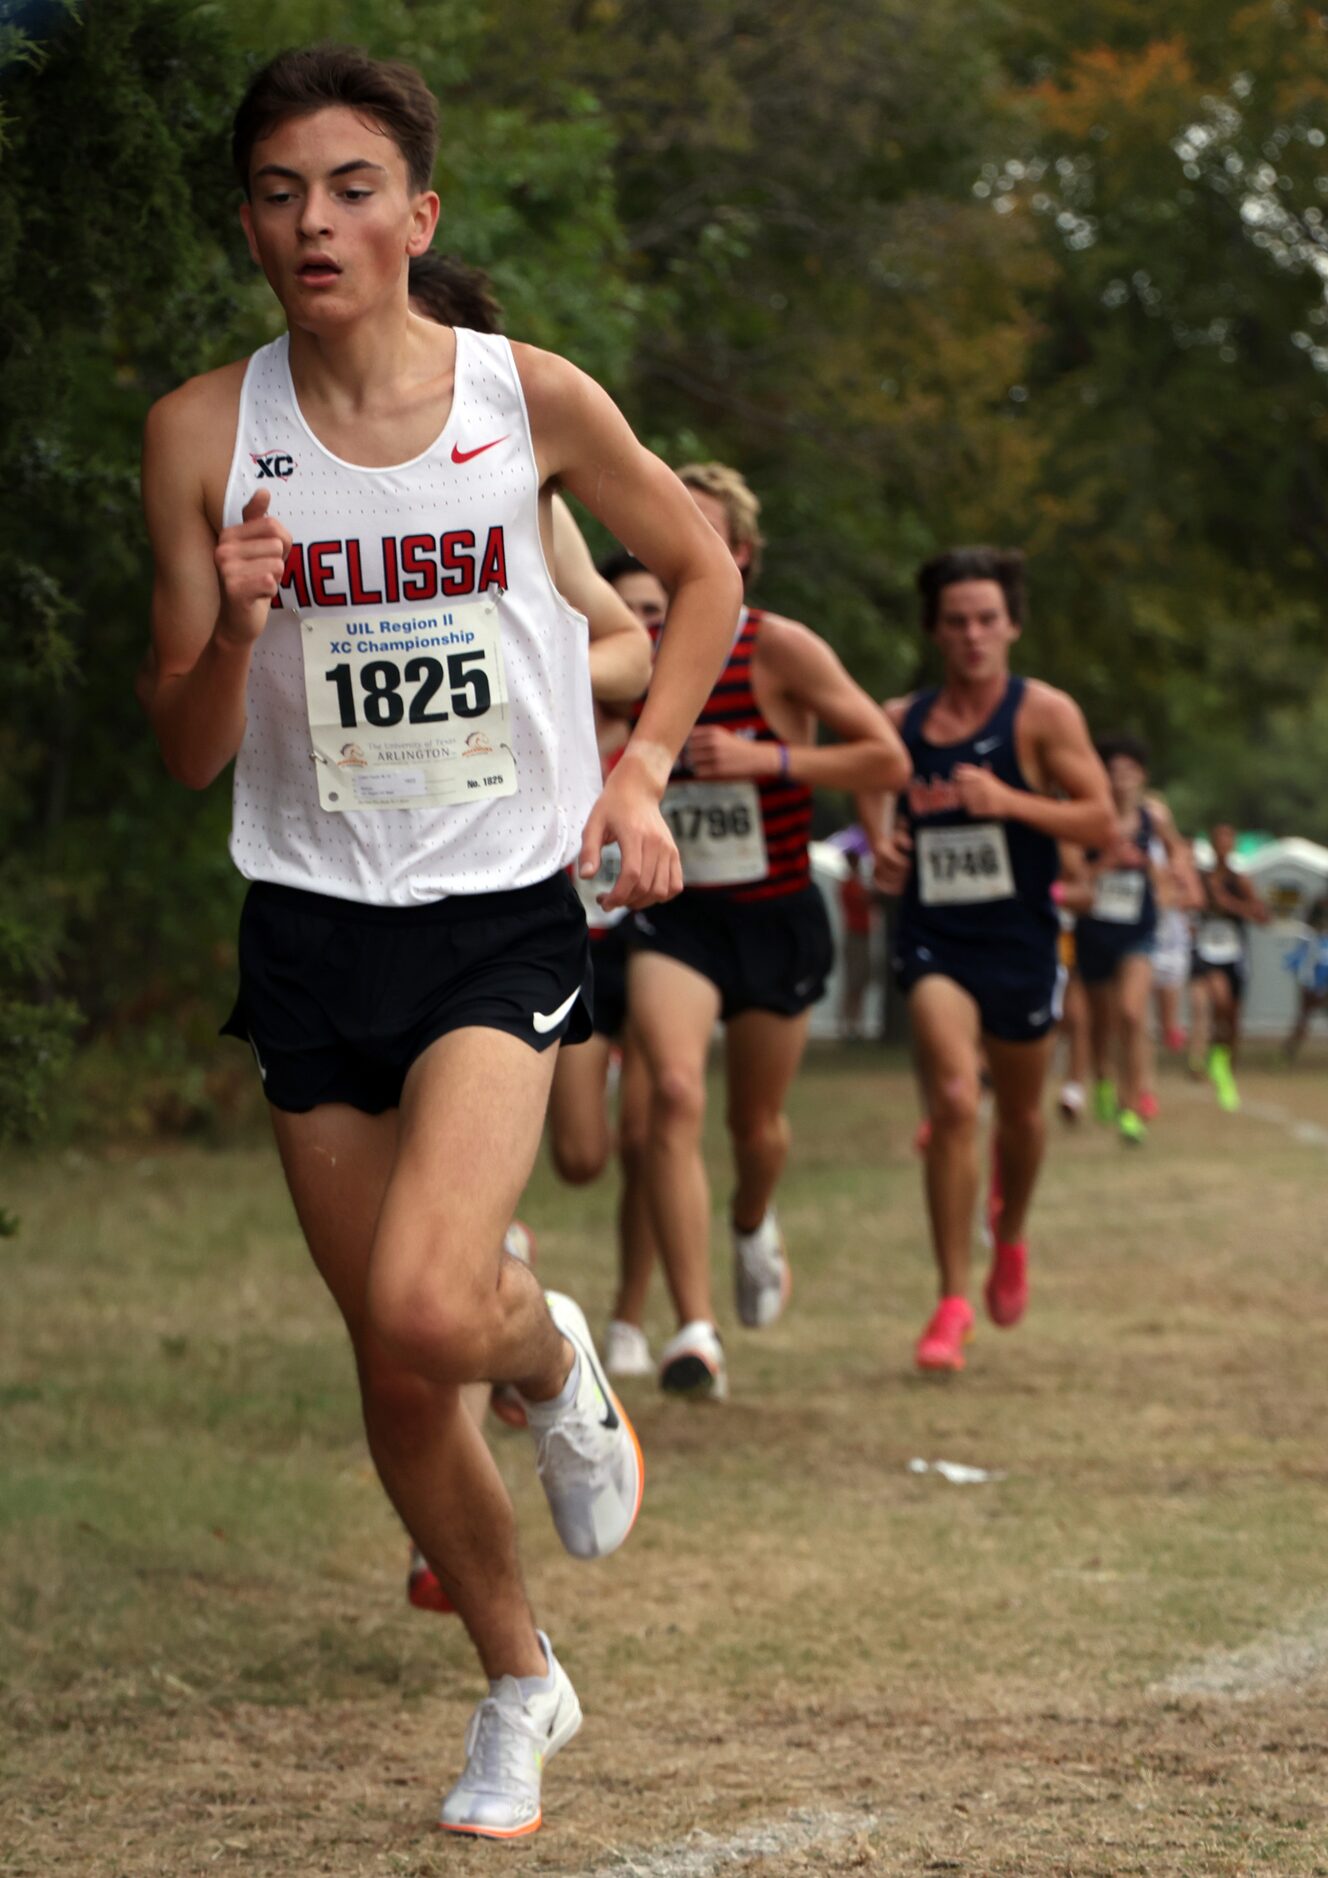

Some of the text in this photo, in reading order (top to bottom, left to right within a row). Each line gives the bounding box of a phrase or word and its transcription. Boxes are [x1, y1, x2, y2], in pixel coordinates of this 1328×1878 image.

[256, 455, 295, 480] XC
[271, 525, 509, 610] MELISSA
[346, 613, 454, 636] UIL Region II
[330, 630, 475, 654] XC Championship
[325, 650, 491, 729] 1825
[368, 737, 456, 750] The University of Texas
[377, 747, 450, 762] ARLINGTON
[467, 775, 504, 789] No. 1825
